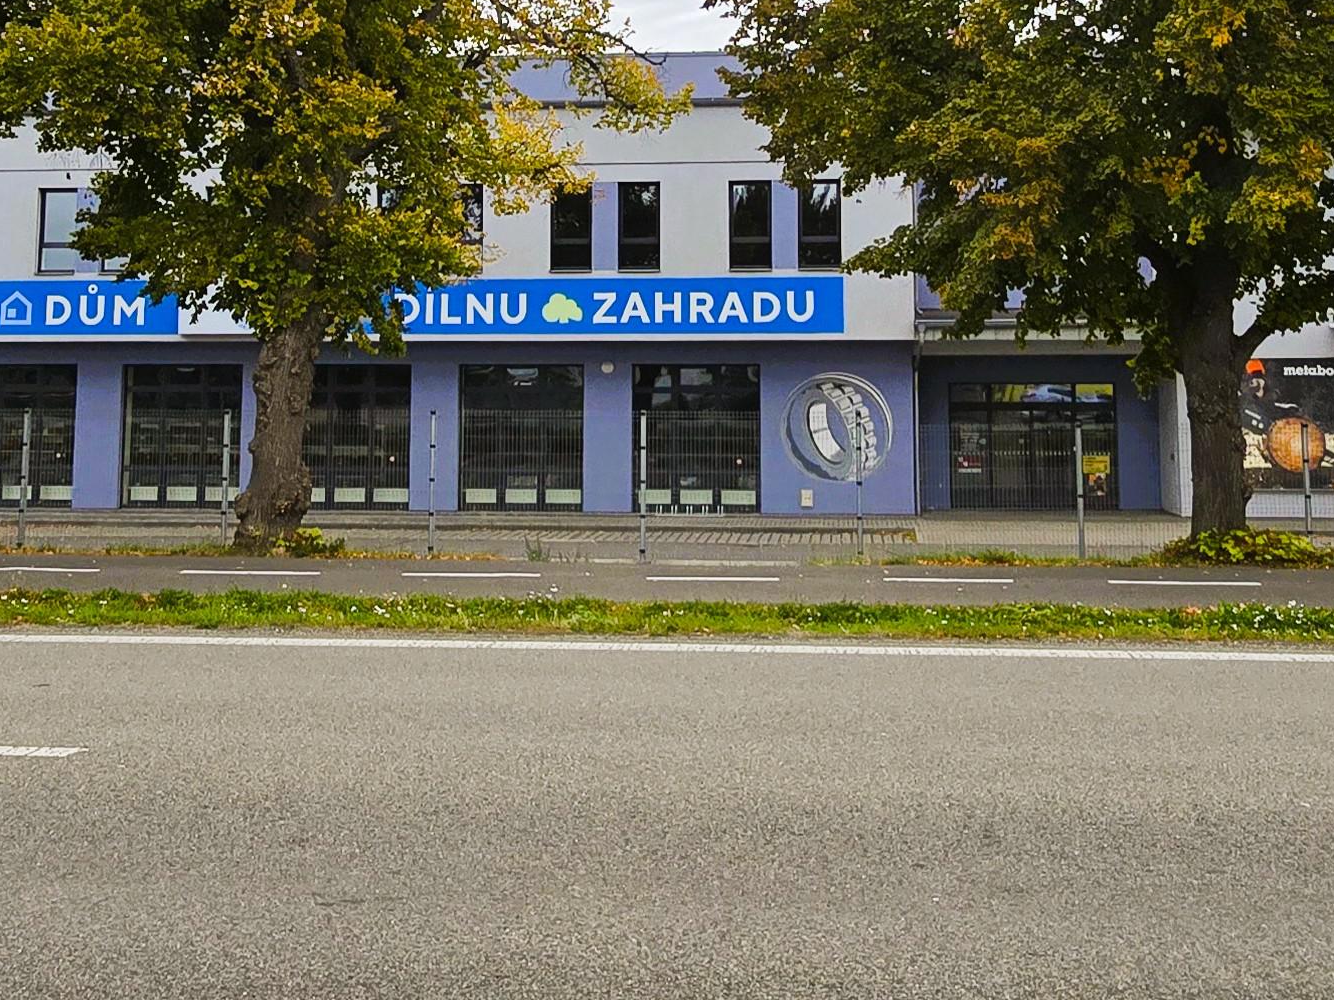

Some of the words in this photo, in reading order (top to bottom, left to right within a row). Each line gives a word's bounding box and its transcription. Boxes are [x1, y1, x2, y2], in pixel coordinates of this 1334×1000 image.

[45, 284, 146, 326] DŮM
[394, 286, 528, 325] DÍLNU
[592, 289, 816, 324] ZAHRADU
[1283, 365, 1334, 376] metabo
